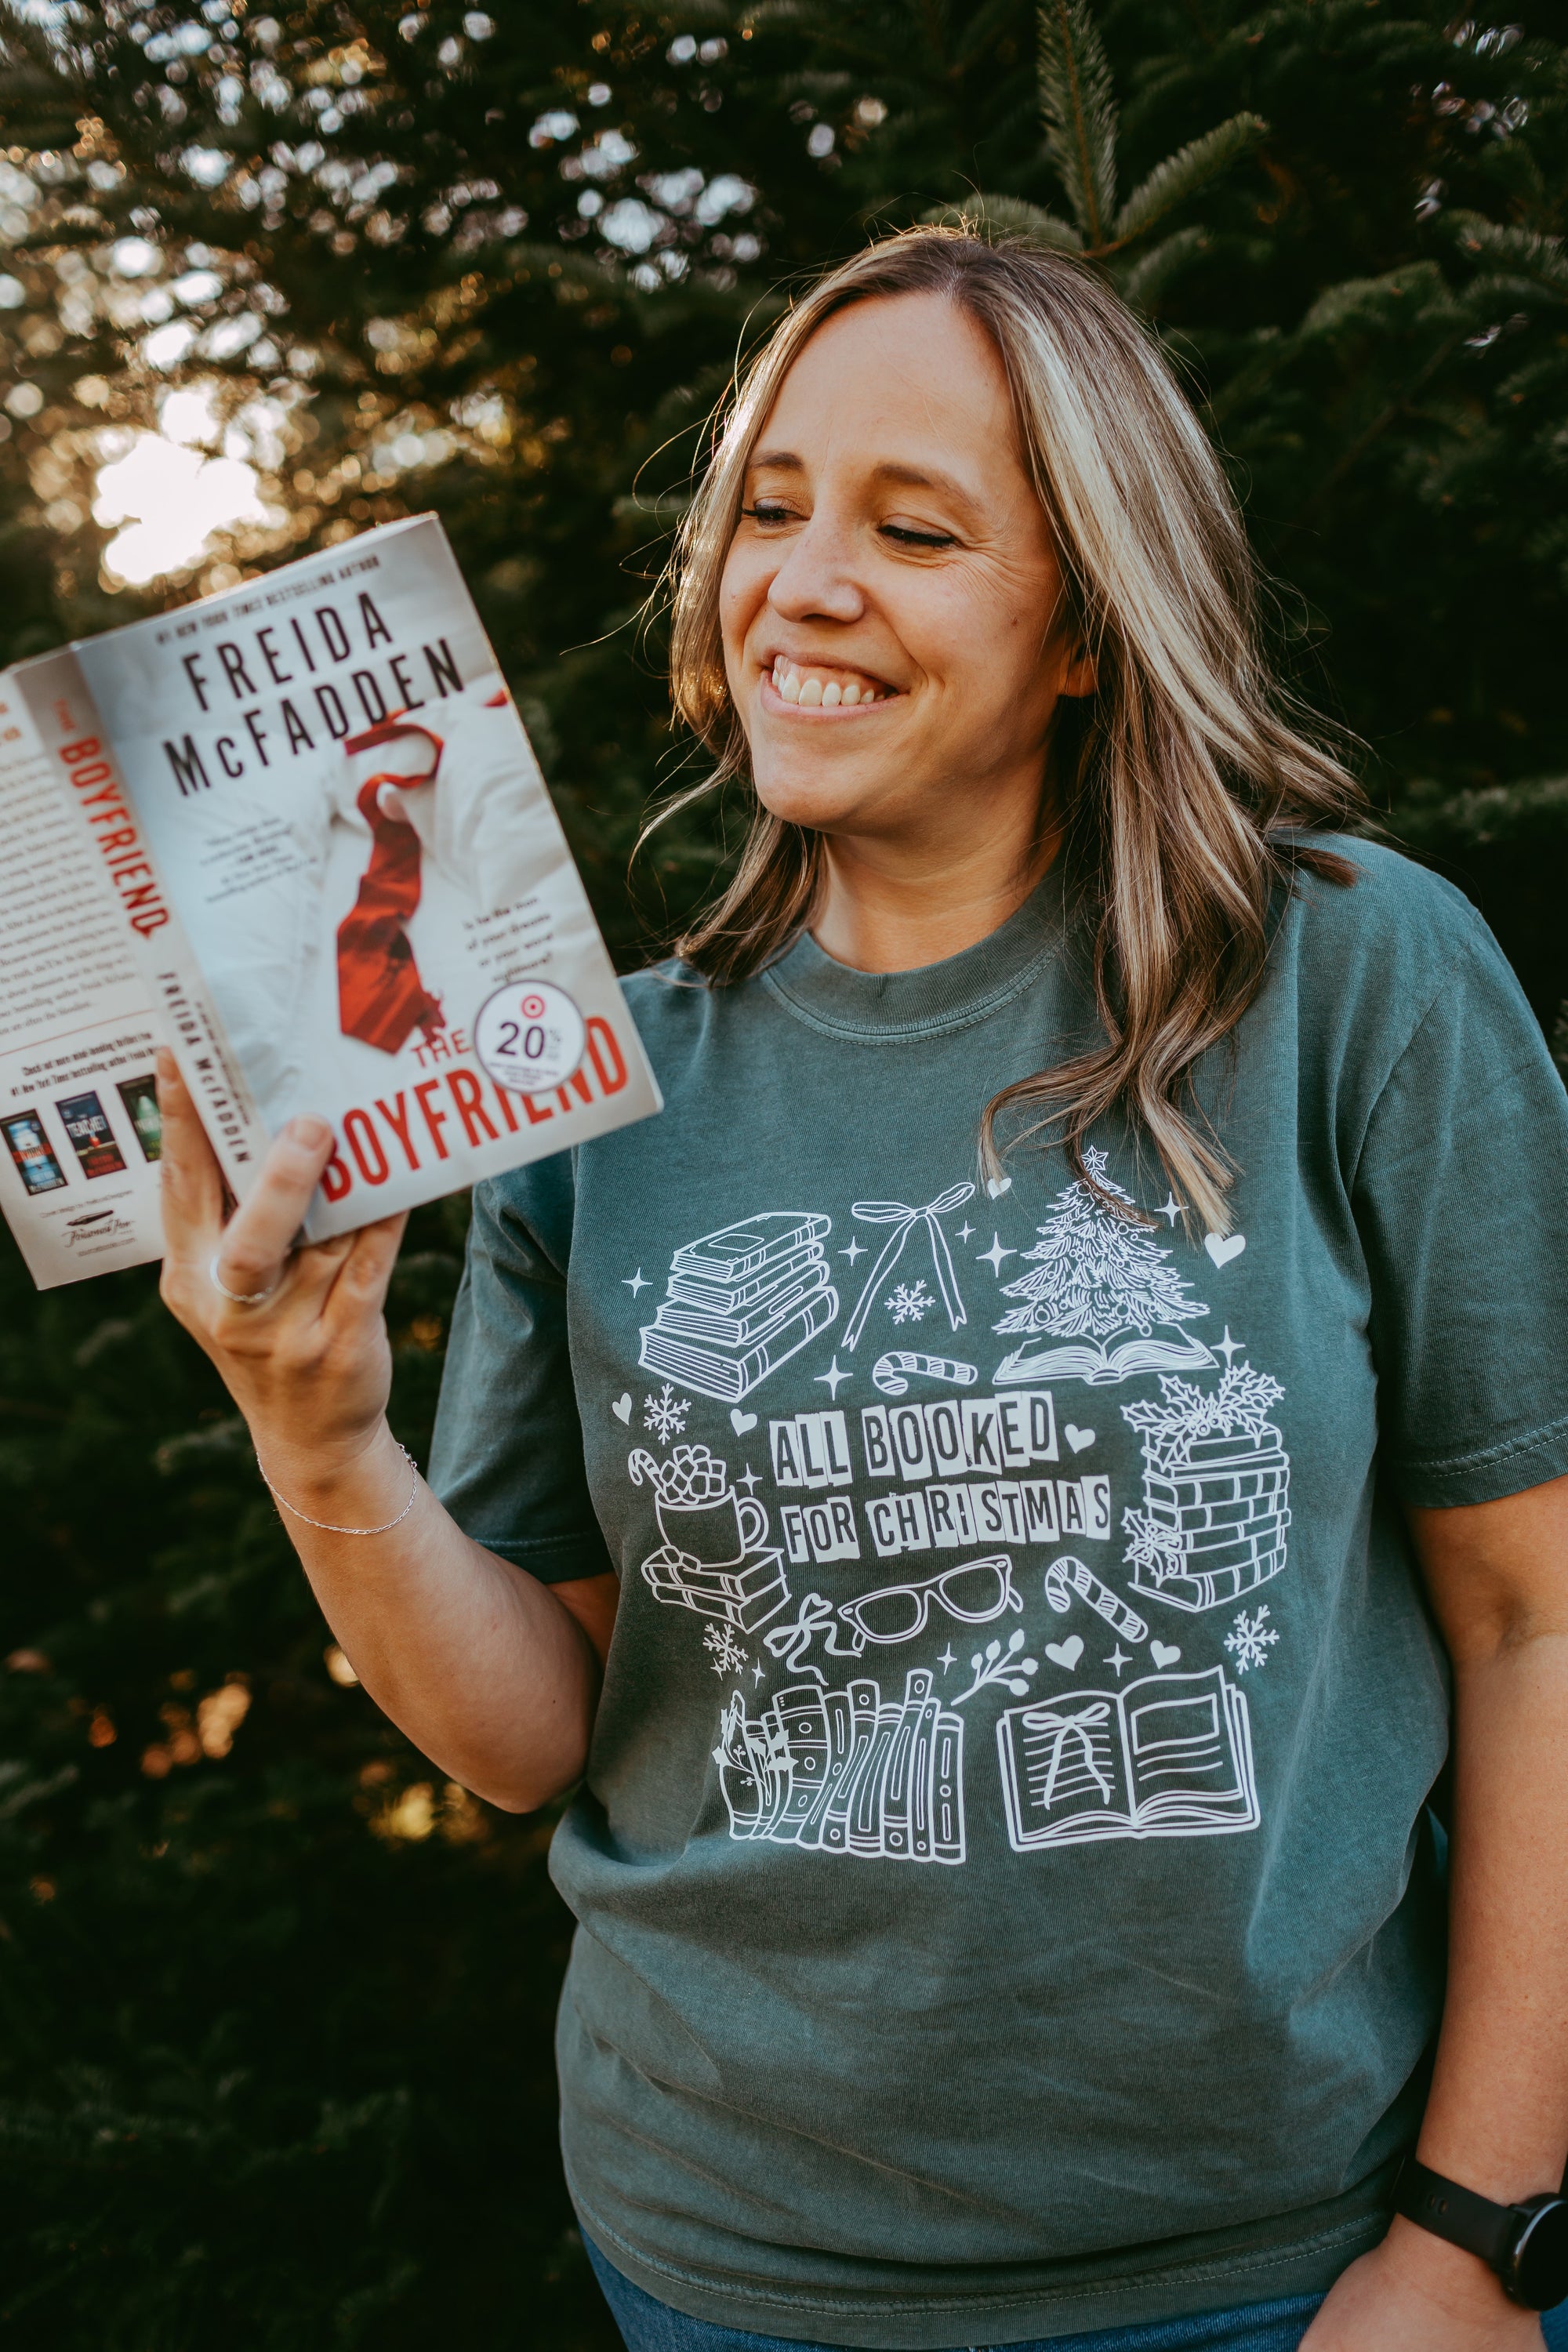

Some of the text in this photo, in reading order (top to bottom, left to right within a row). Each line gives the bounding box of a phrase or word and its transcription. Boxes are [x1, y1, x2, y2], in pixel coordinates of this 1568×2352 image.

[181, 590, 394, 711] FREIDA
[162, 637, 466, 797] McFADDEN
[57, 736, 170, 938] BOYFRIEND
[157, 971, 202, 1047] FREIDA
[195, 1058, 252, 1164] McFADDEN
[410, 1029, 474, 1069] THE
[775, 1394, 1053, 1482] ALL BOOKED
[783, 1481, 1110, 1556] FOR CHRISTMAS
